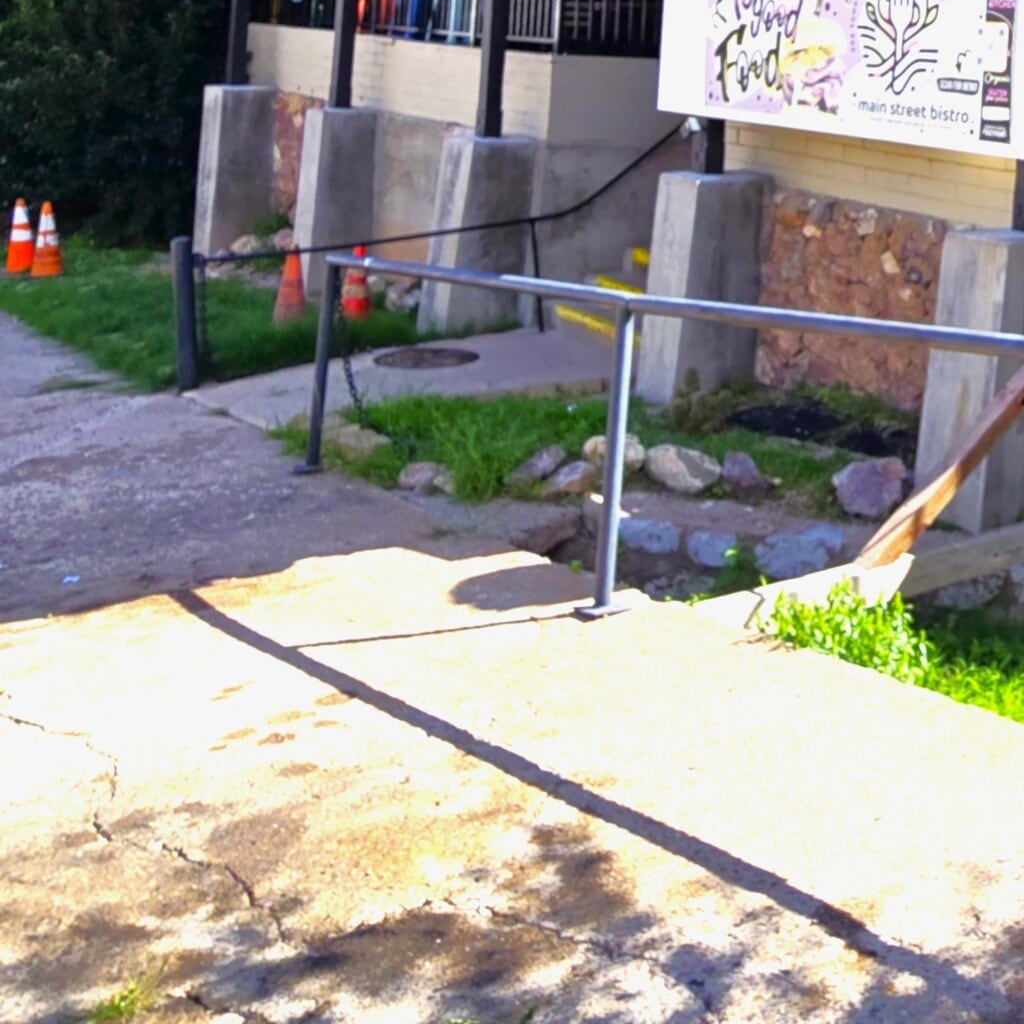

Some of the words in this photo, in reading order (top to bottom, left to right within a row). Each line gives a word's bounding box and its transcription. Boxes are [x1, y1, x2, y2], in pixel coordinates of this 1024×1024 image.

[714, 24, 784, 103] Food
[858, 98, 887, 114] main
[890, 103, 926, 119] street
[930, 104, 969, 124] bistro
